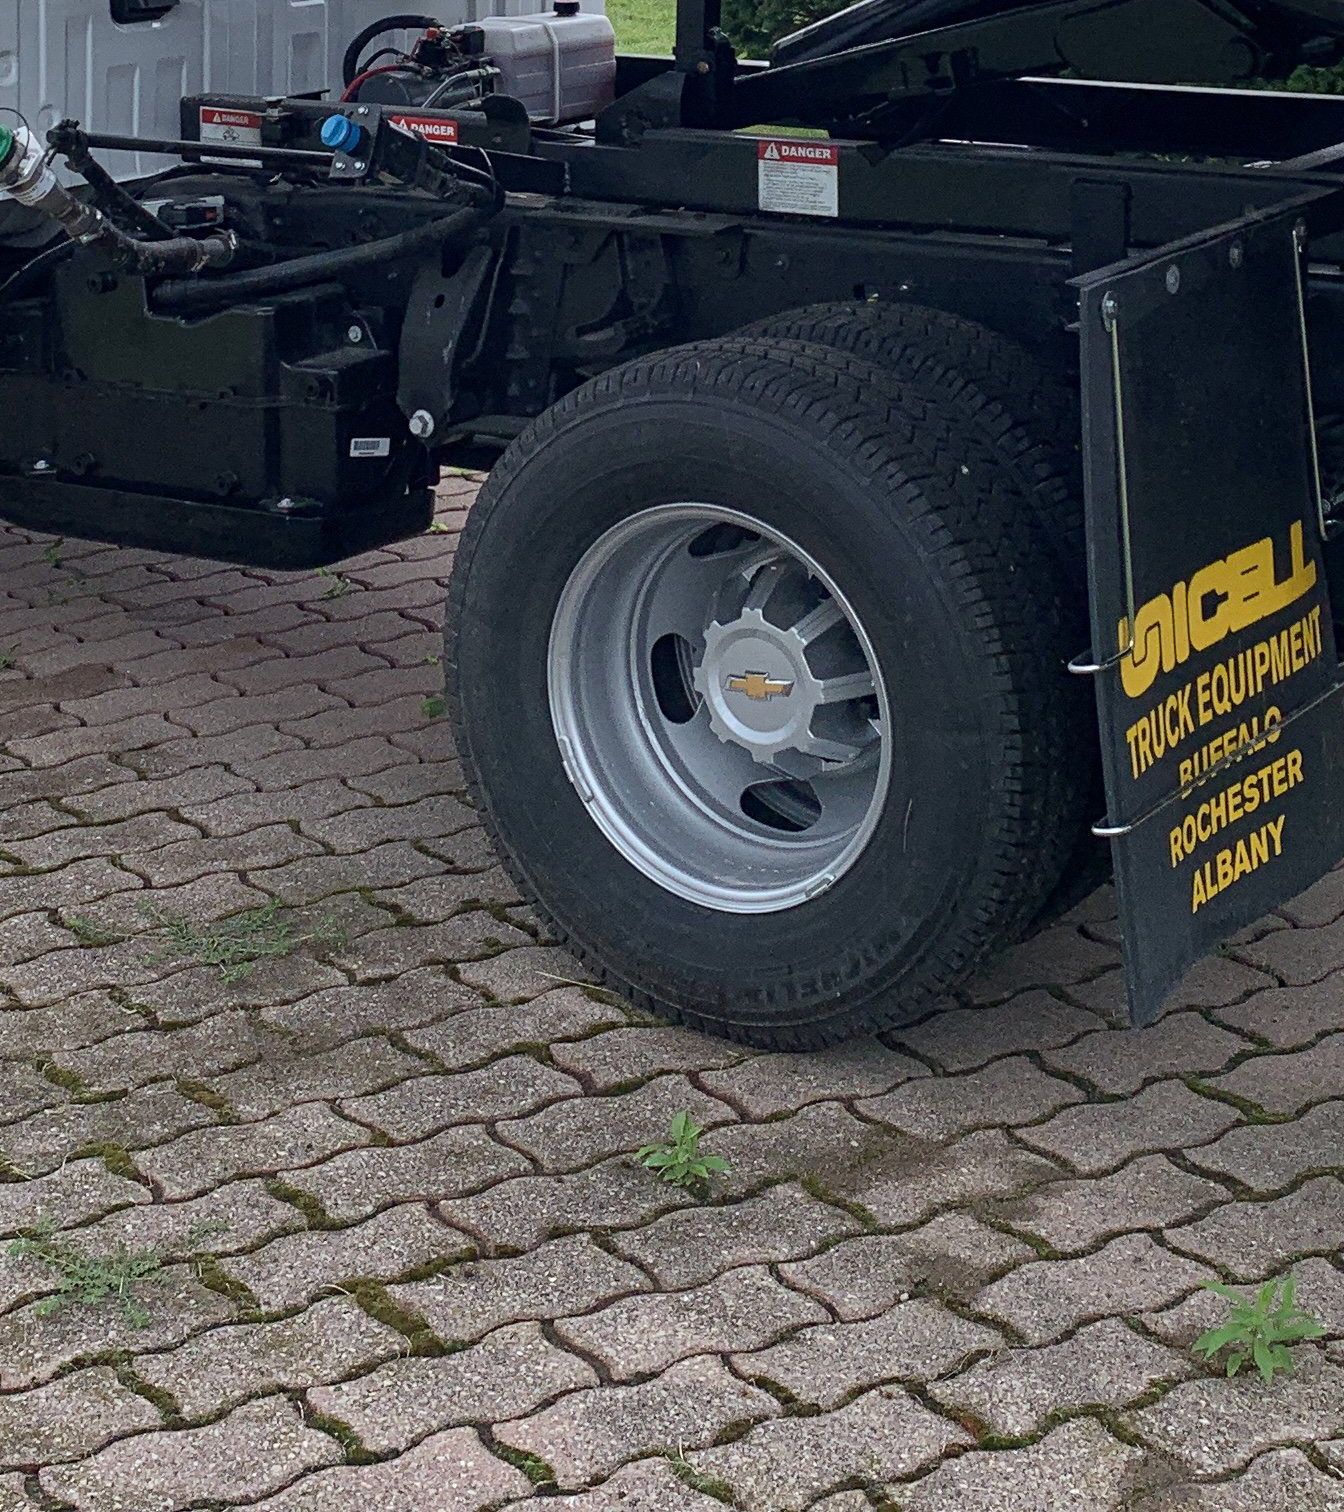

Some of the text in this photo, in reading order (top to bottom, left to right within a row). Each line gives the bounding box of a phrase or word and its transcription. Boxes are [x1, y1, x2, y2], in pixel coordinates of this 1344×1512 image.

[221, 113, 249, 125] DANGER
[781, 145, 831, 159] DANGER
[1118, 519, 1317, 698] UNICELL
[1126, 605, 1323, 780] TRUCK EQUIPMENT
[1179, 705, 1283, 800] BUFFALO
[1169, 749, 1304, 869] ROCHESTER
[1191, 814, 1286, 914] ALBANY
